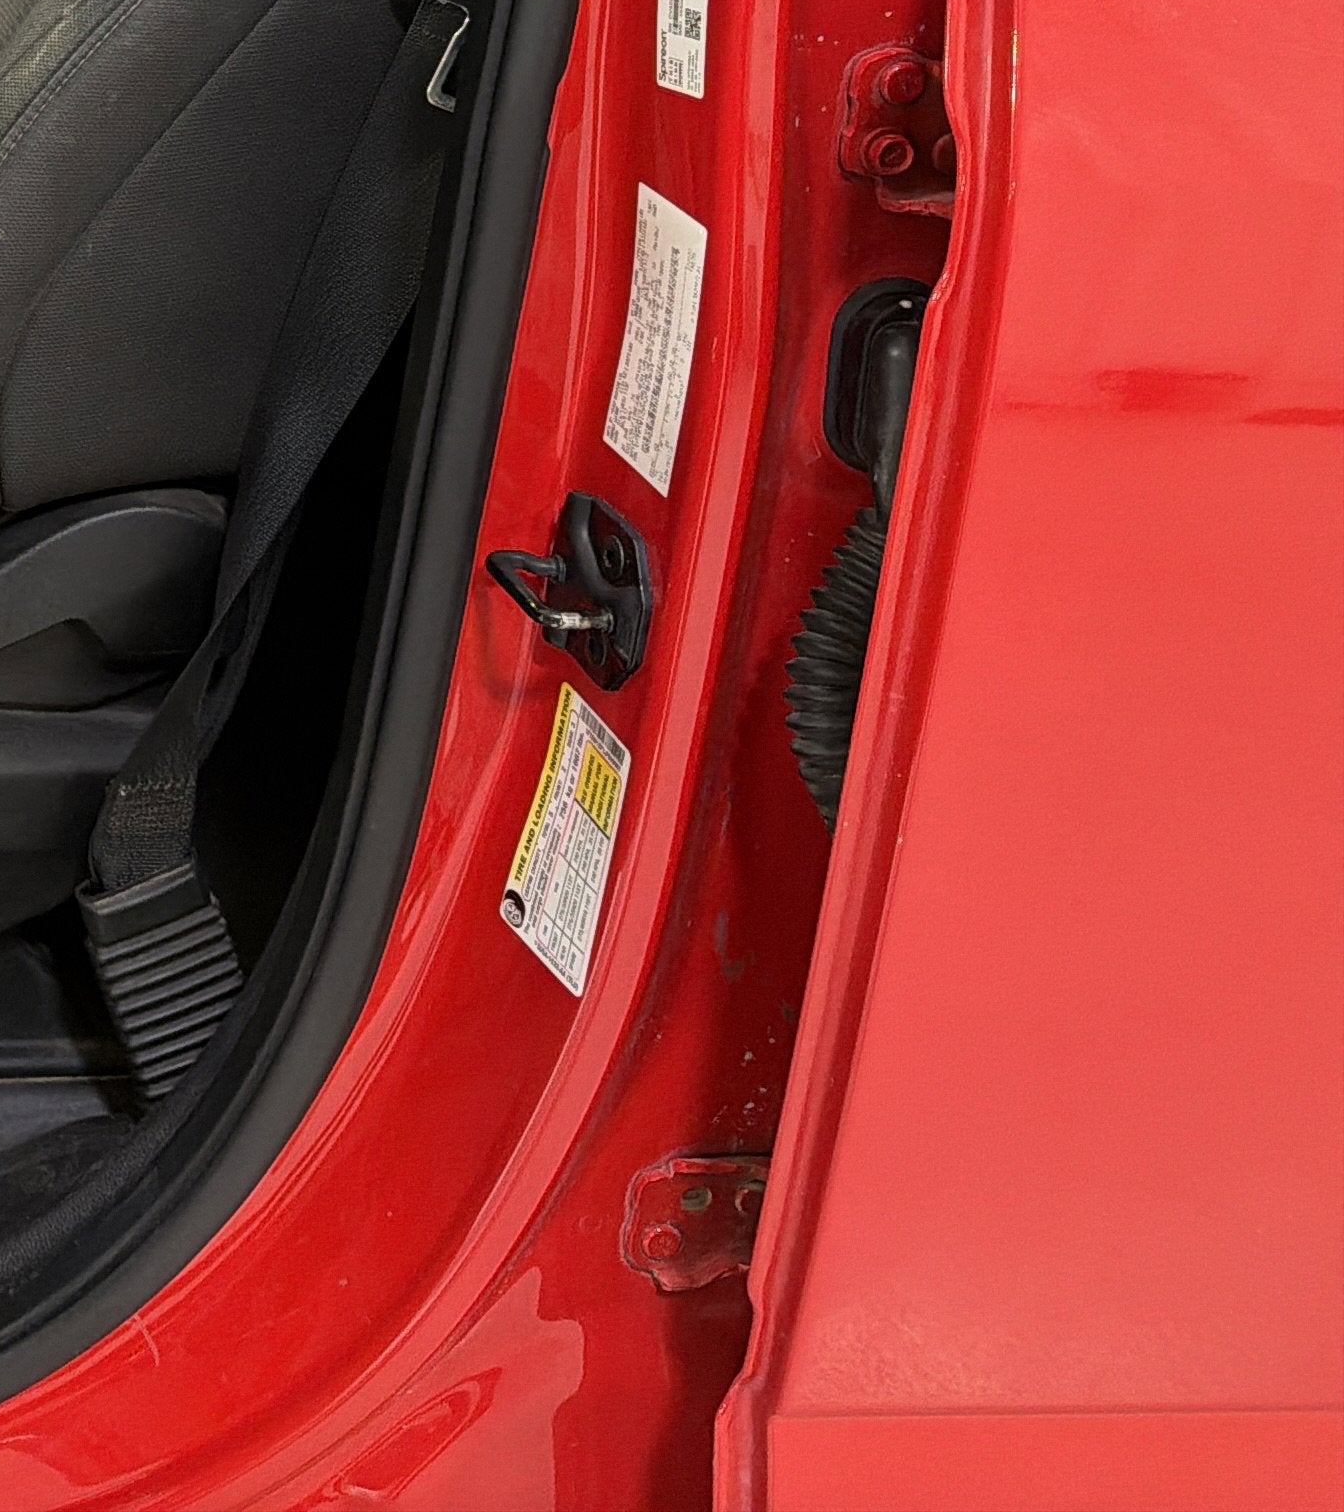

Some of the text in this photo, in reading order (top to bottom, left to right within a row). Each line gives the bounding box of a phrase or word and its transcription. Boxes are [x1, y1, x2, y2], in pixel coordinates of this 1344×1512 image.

[514, 688, 573, 883] TIRE AND LOADING INFORMATION
